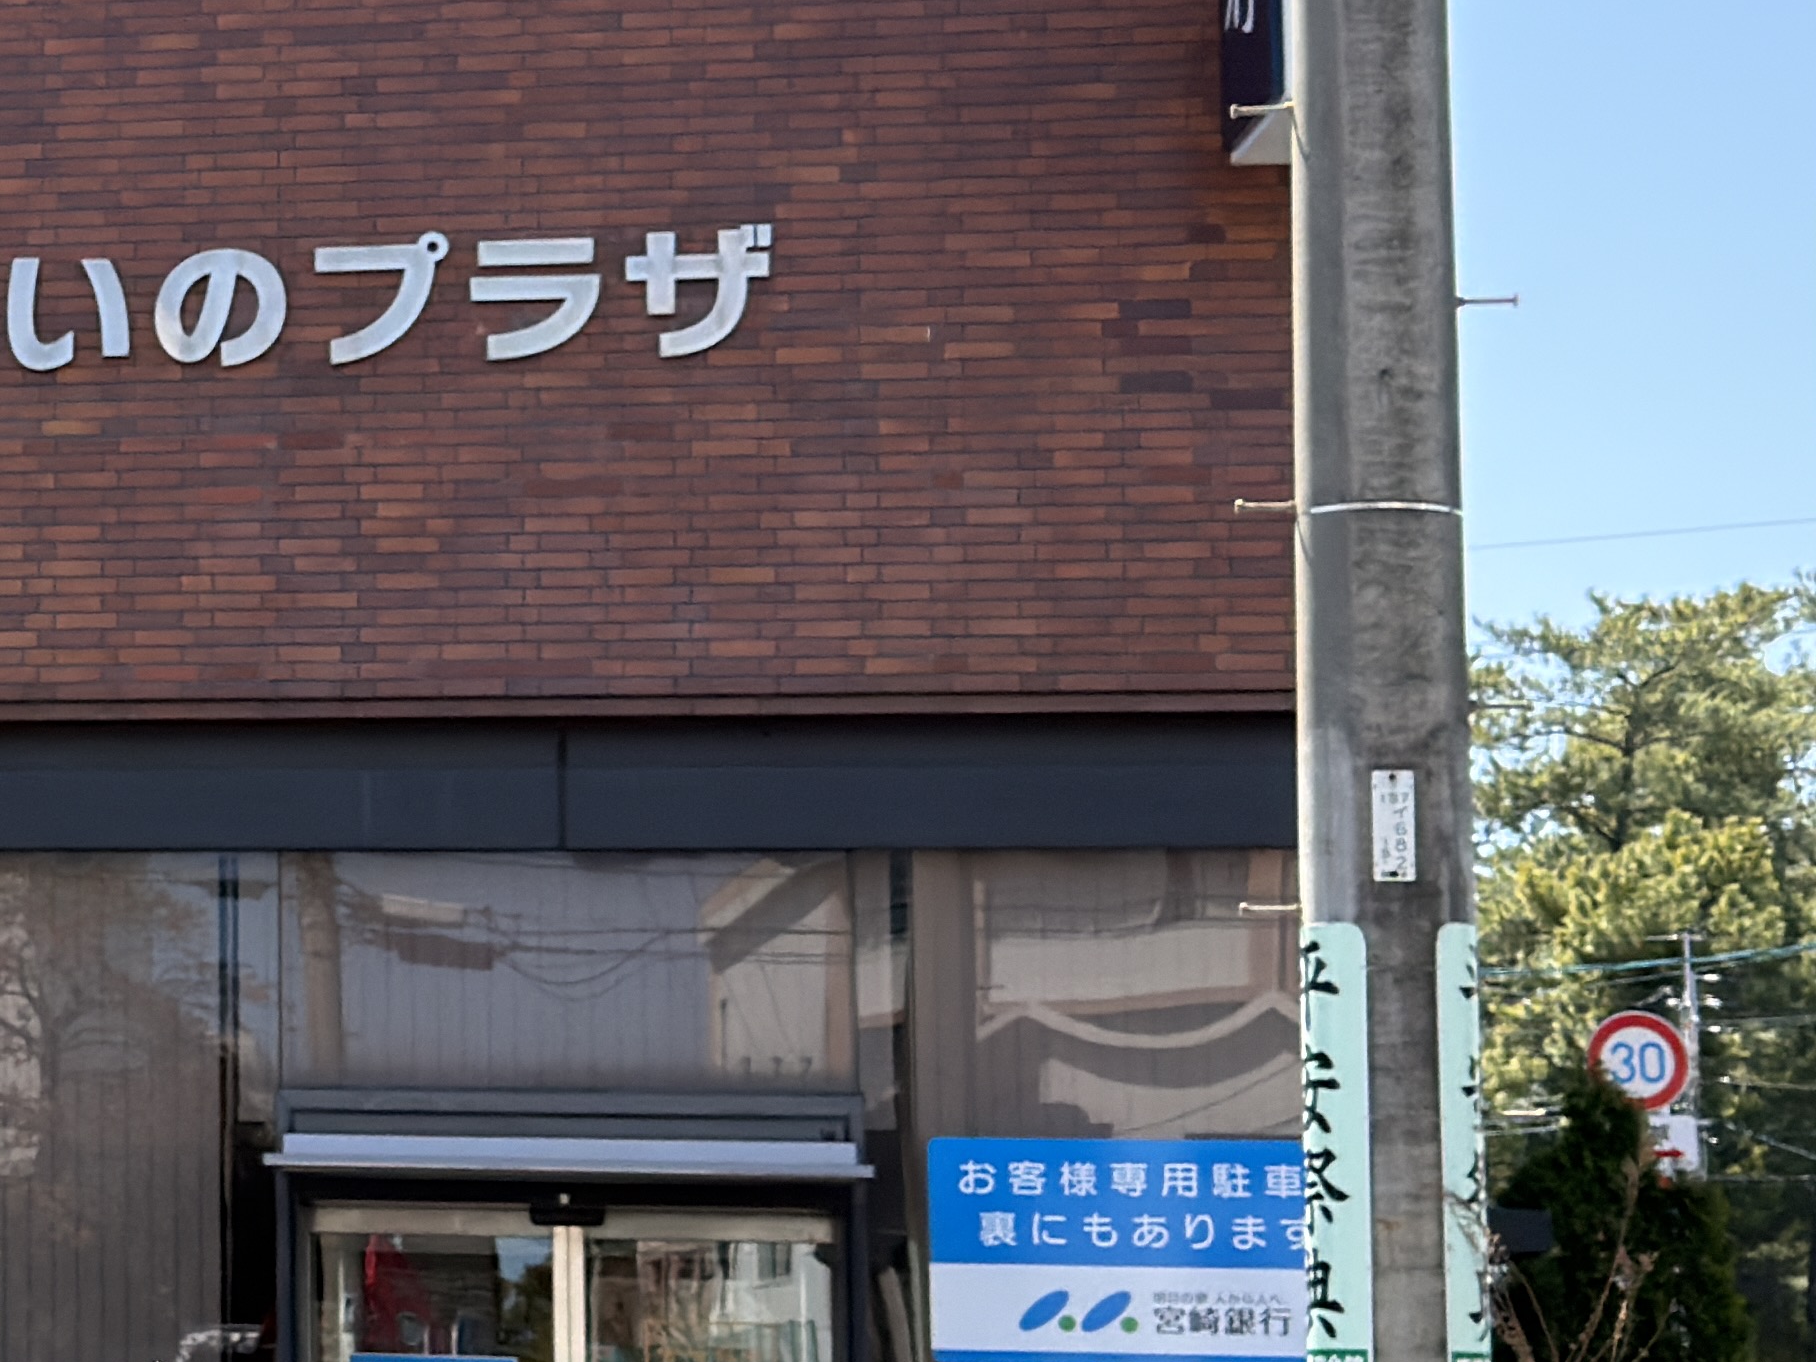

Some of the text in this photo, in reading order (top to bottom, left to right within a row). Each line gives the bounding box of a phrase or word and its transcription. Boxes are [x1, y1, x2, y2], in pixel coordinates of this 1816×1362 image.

[1612, 1042, 1665, 1083] 30
[958, 1160, 1303, 1199] お客様専用駐車
[1153, 1306, 1292, 1336] 宮崎銀行
